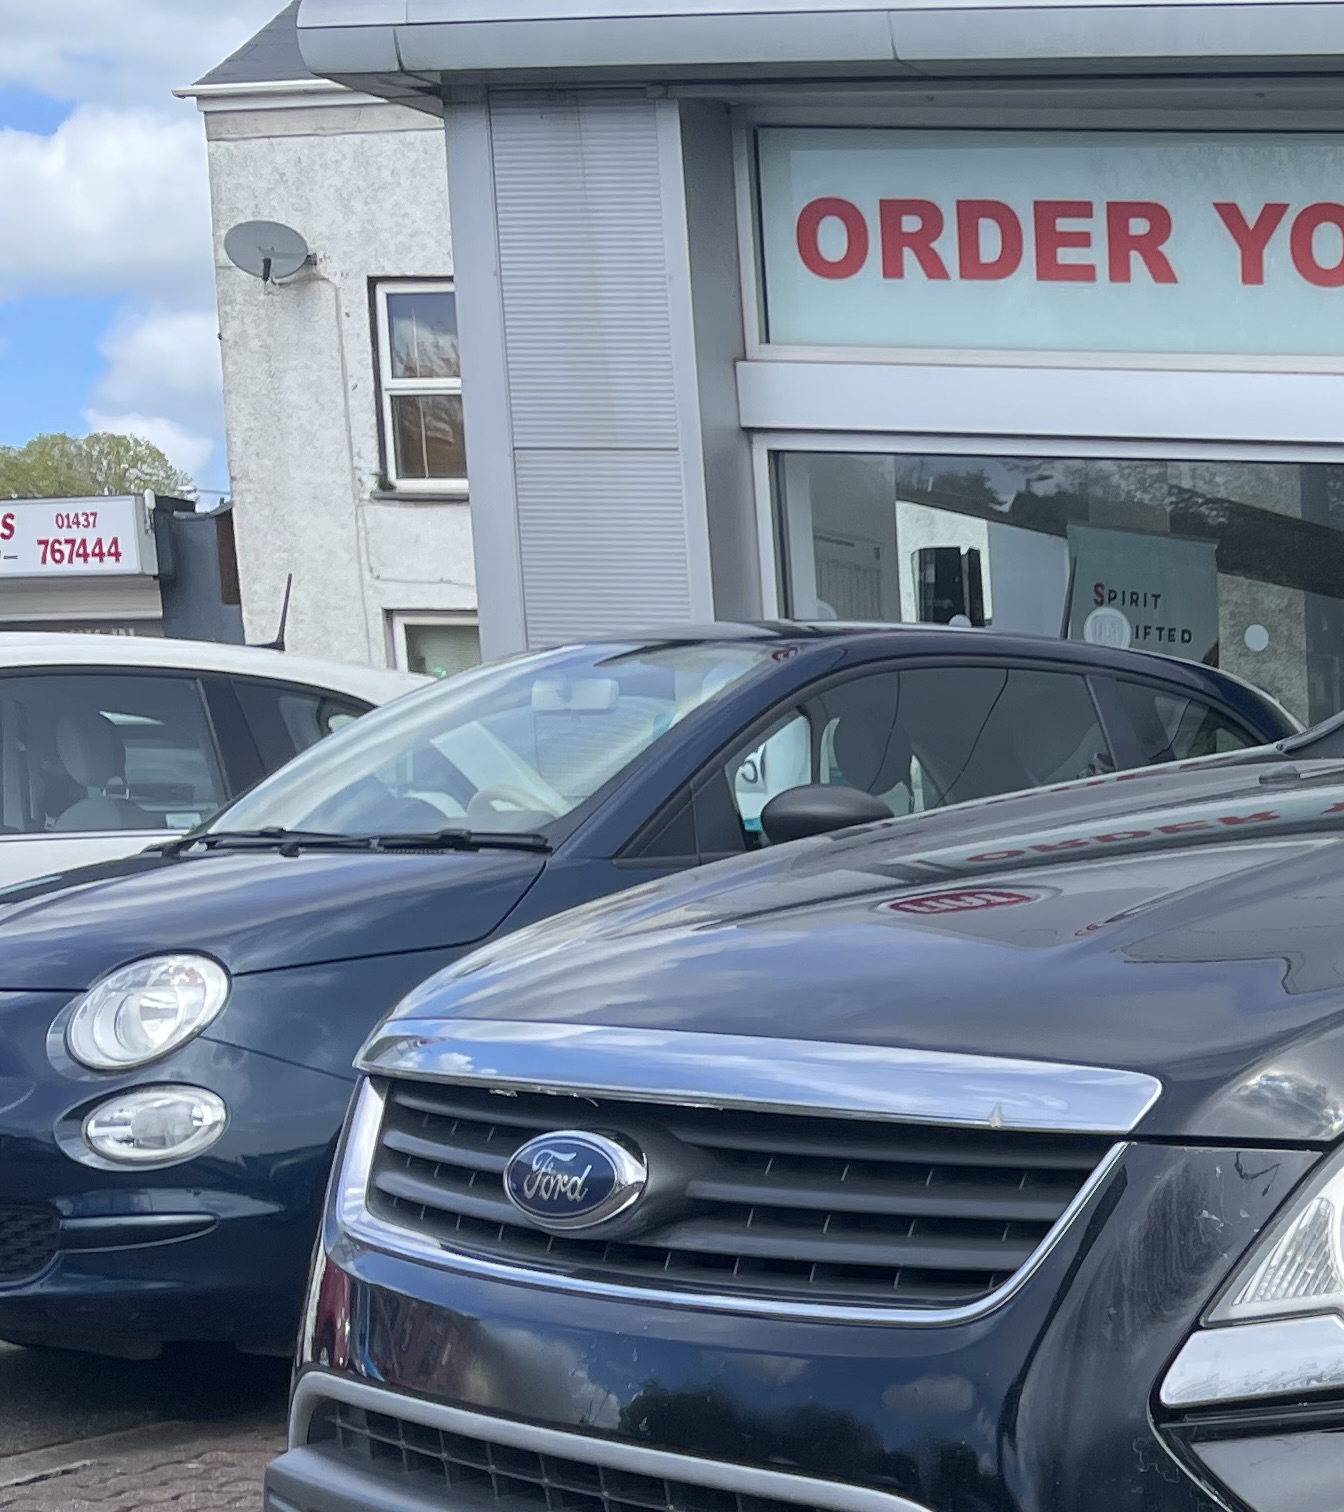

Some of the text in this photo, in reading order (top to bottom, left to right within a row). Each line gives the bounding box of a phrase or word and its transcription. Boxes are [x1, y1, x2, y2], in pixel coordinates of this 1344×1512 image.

[795, 197, 1178, 284] ORDER
[55, 511, 98, 530] 01437
[37, 536, 122, 565] 767444
[523, 1149, 593, 1203] Ford
